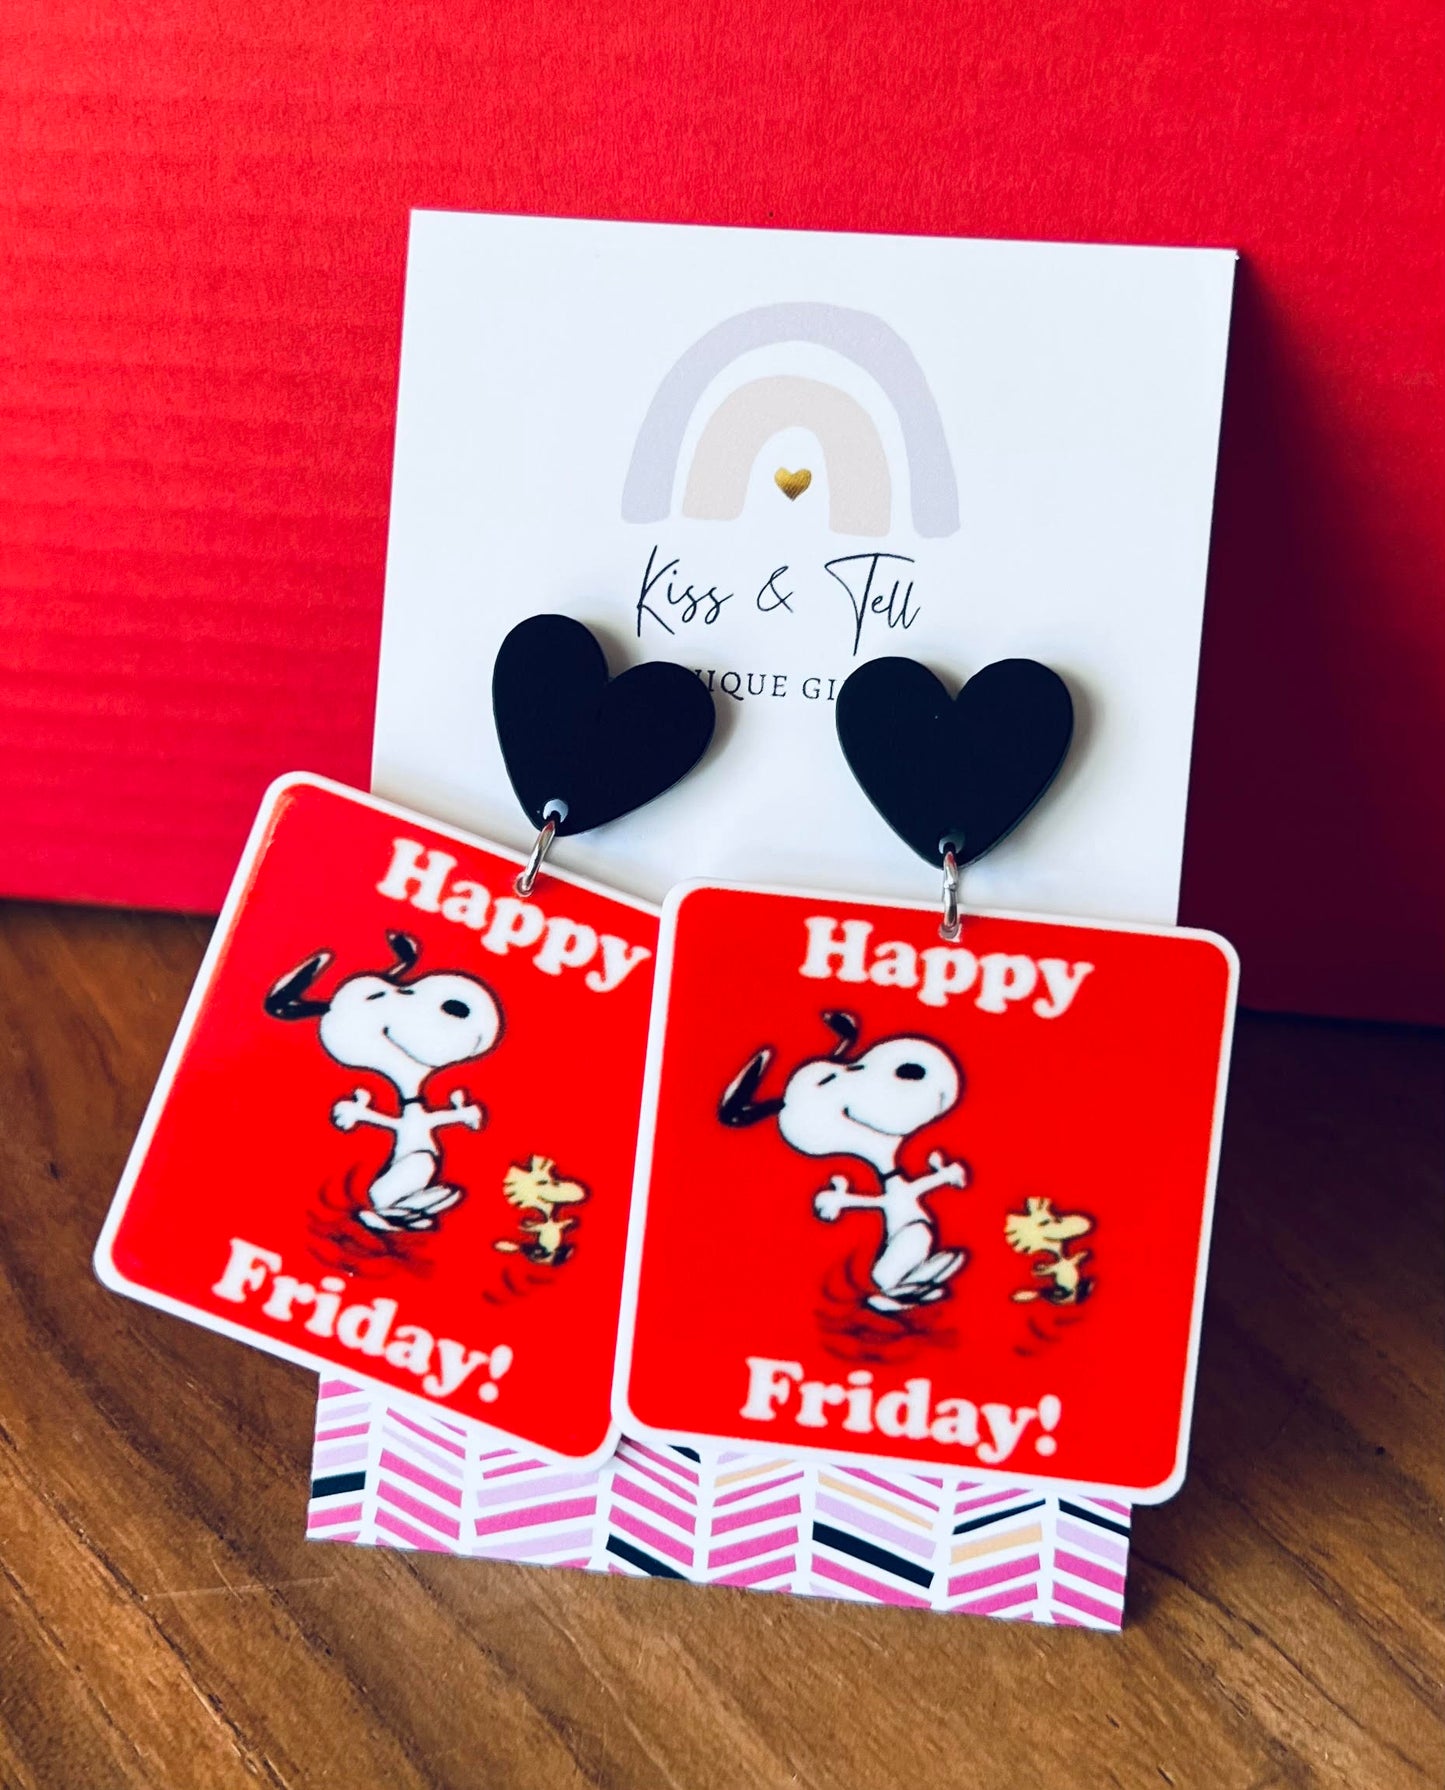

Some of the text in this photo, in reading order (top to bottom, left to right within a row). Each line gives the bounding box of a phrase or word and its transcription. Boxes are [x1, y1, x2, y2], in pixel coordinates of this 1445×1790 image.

[637, 545, 921, 657] Kiss & Tell
[694, 669, 844, 701] IQUE GI
[376, 837, 652, 993] Happy
[799, 915, 1096, 1019] Happy
[211, 1237, 514, 1403] Friday!
[739, 1356, 1062, 1464] Friday!
